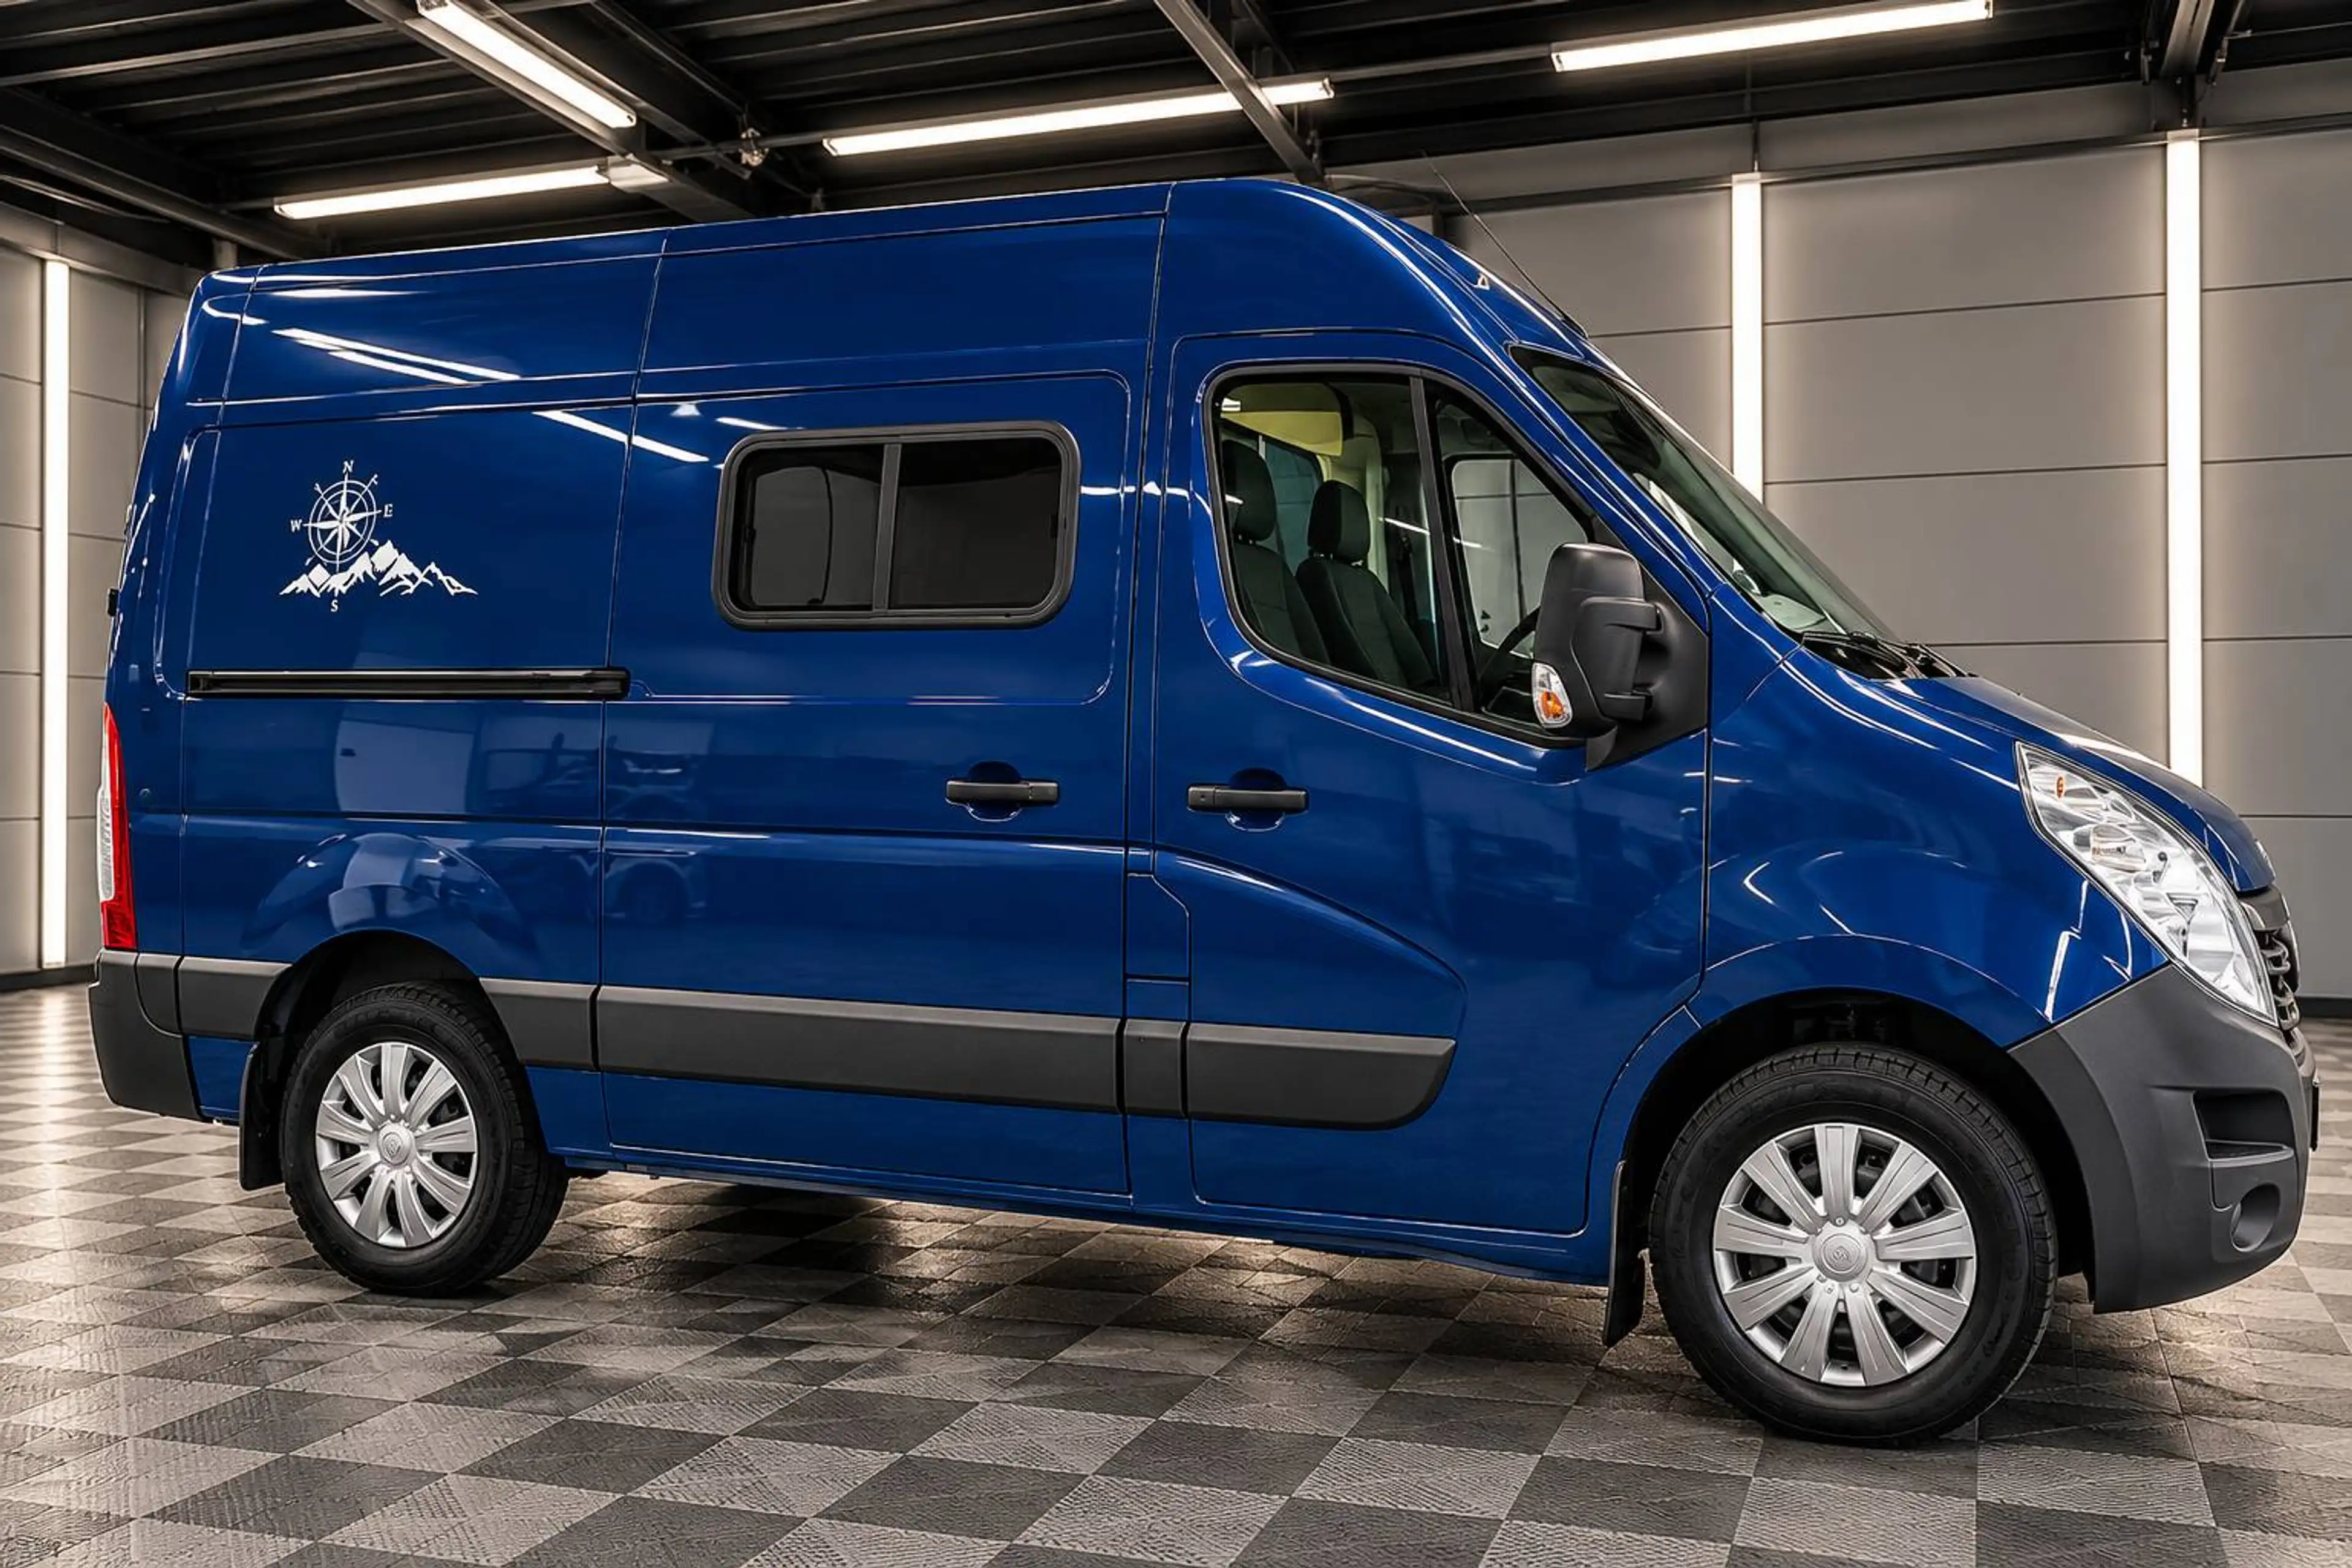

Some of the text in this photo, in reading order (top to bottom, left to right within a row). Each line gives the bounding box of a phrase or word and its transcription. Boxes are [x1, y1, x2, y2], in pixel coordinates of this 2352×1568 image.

[343, 460, 354, 473] N
[383, 503, 393, 517] E
[291, 519, 303, 532] W
[331, 599, 338, 612] S
